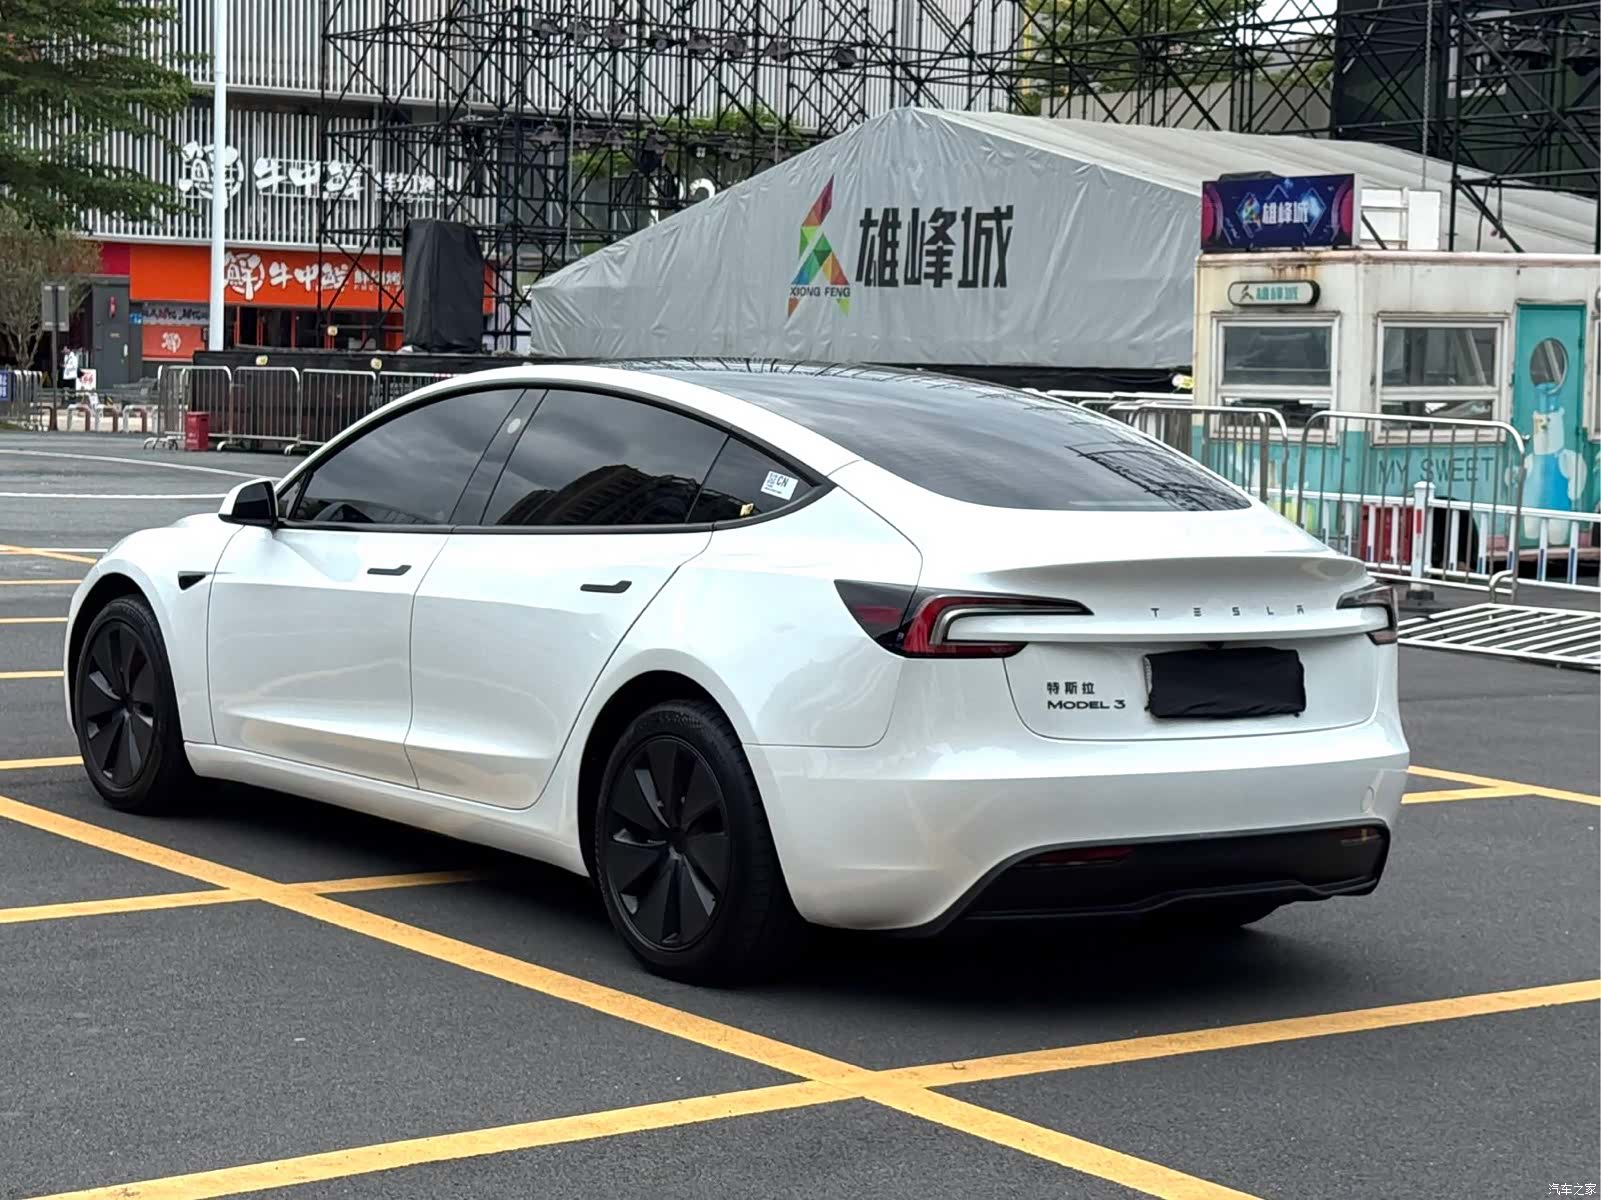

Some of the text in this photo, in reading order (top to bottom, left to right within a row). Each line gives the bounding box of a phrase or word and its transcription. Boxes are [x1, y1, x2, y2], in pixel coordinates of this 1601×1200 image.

[1261, 201, 1309, 225] 雄峰城
[855, 204, 1014, 289] 雄峰城
[790, 286, 851, 298] XIONG FENG
[1378, 457, 1494, 484] MY SWEET
[1150, 604, 1304, 618] TESLA
[1046, 681, 1095, 695] 特斯拉
[1047, 699, 1126, 710] MODEL 3
